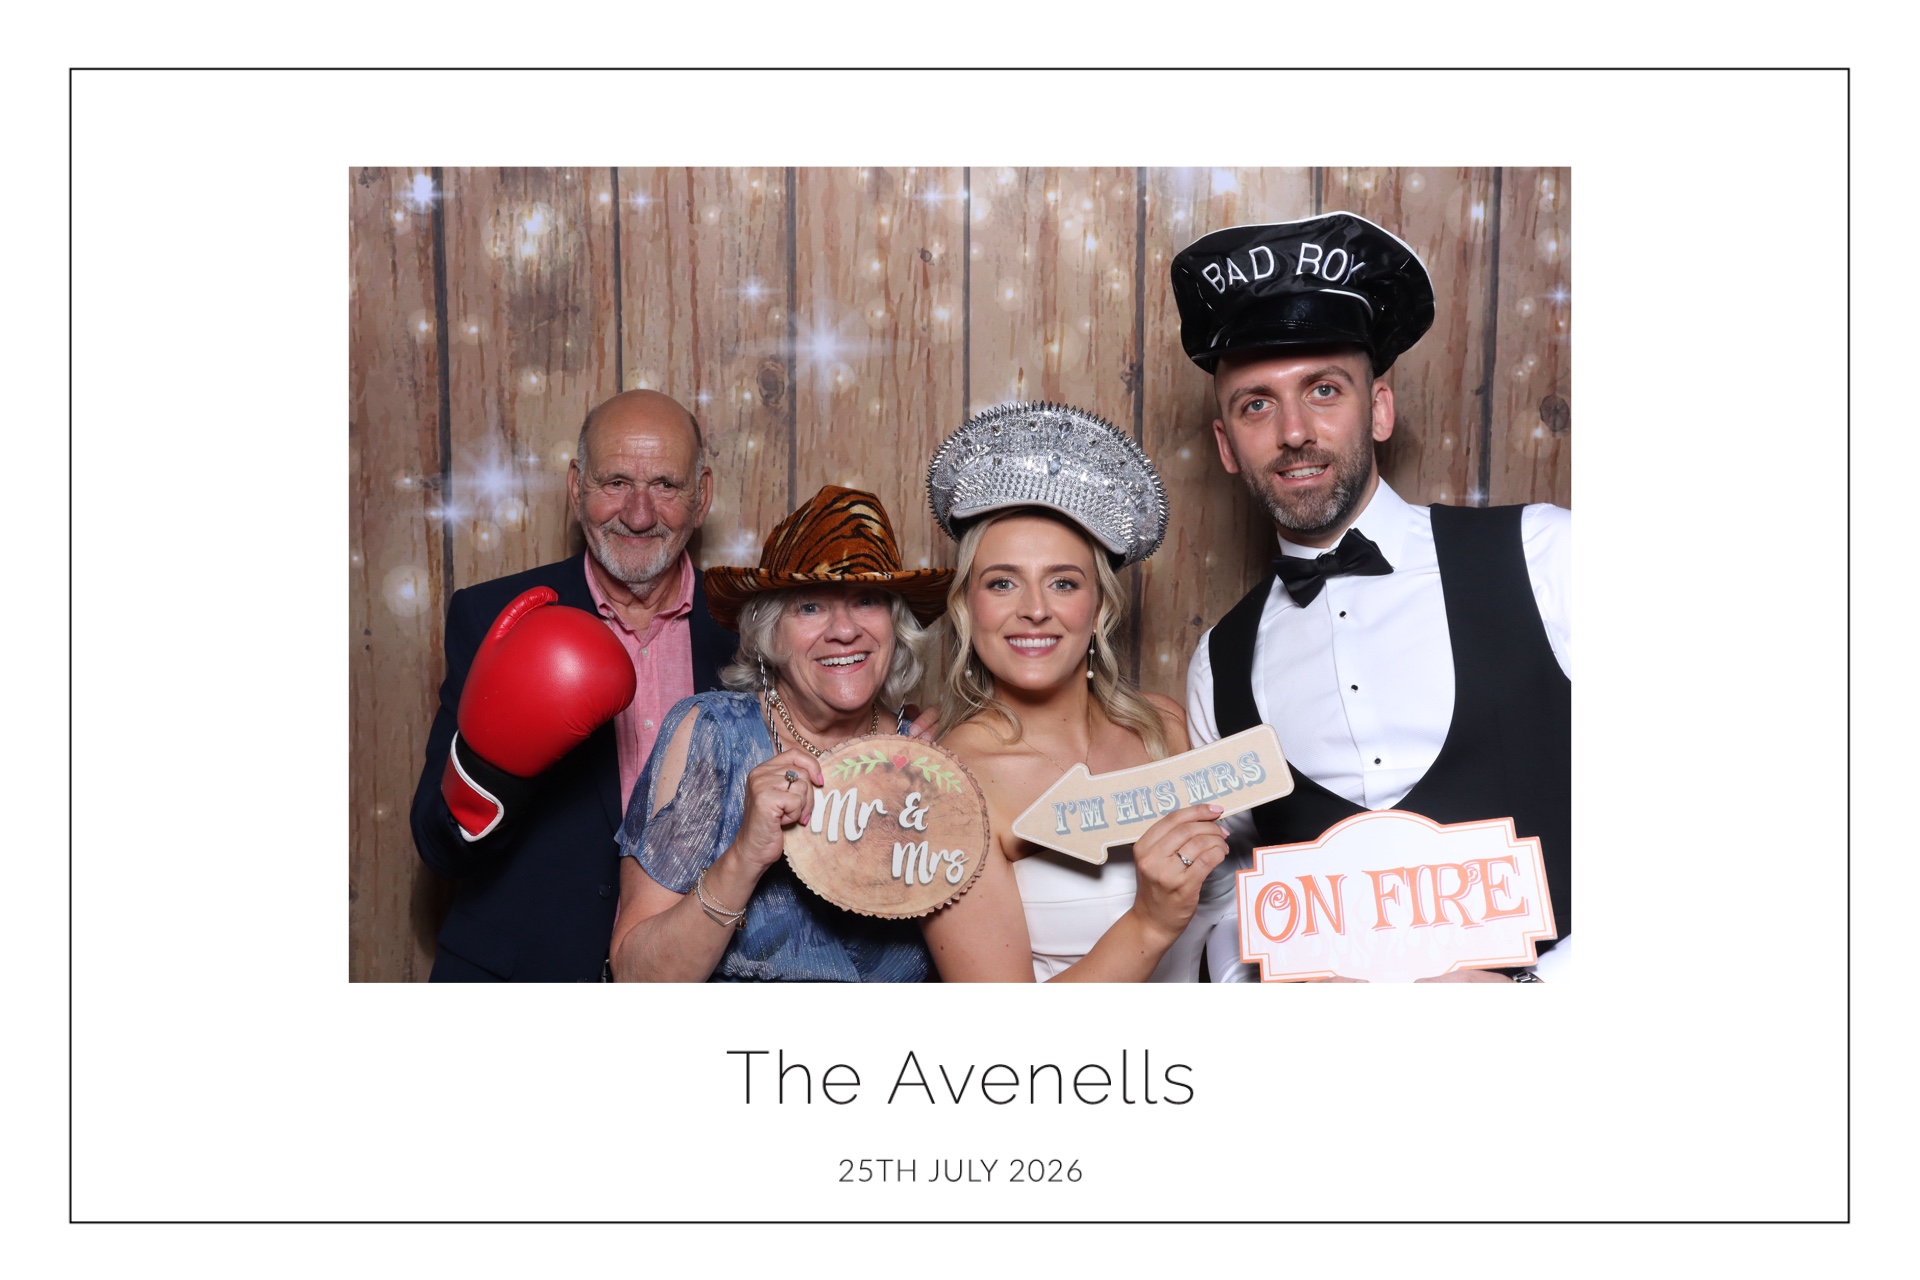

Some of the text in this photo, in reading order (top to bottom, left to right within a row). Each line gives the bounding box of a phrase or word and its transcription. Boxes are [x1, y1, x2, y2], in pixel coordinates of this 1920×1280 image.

[1201, 242, 1366, 294] BAD BOY
[810, 787, 930, 842] Mr &
[1052, 750, 1267, 836] I'M HIS MRS
[891, 840, 970, 885] Mrs
[1254, 854, 1530, 944] ON FIRE
